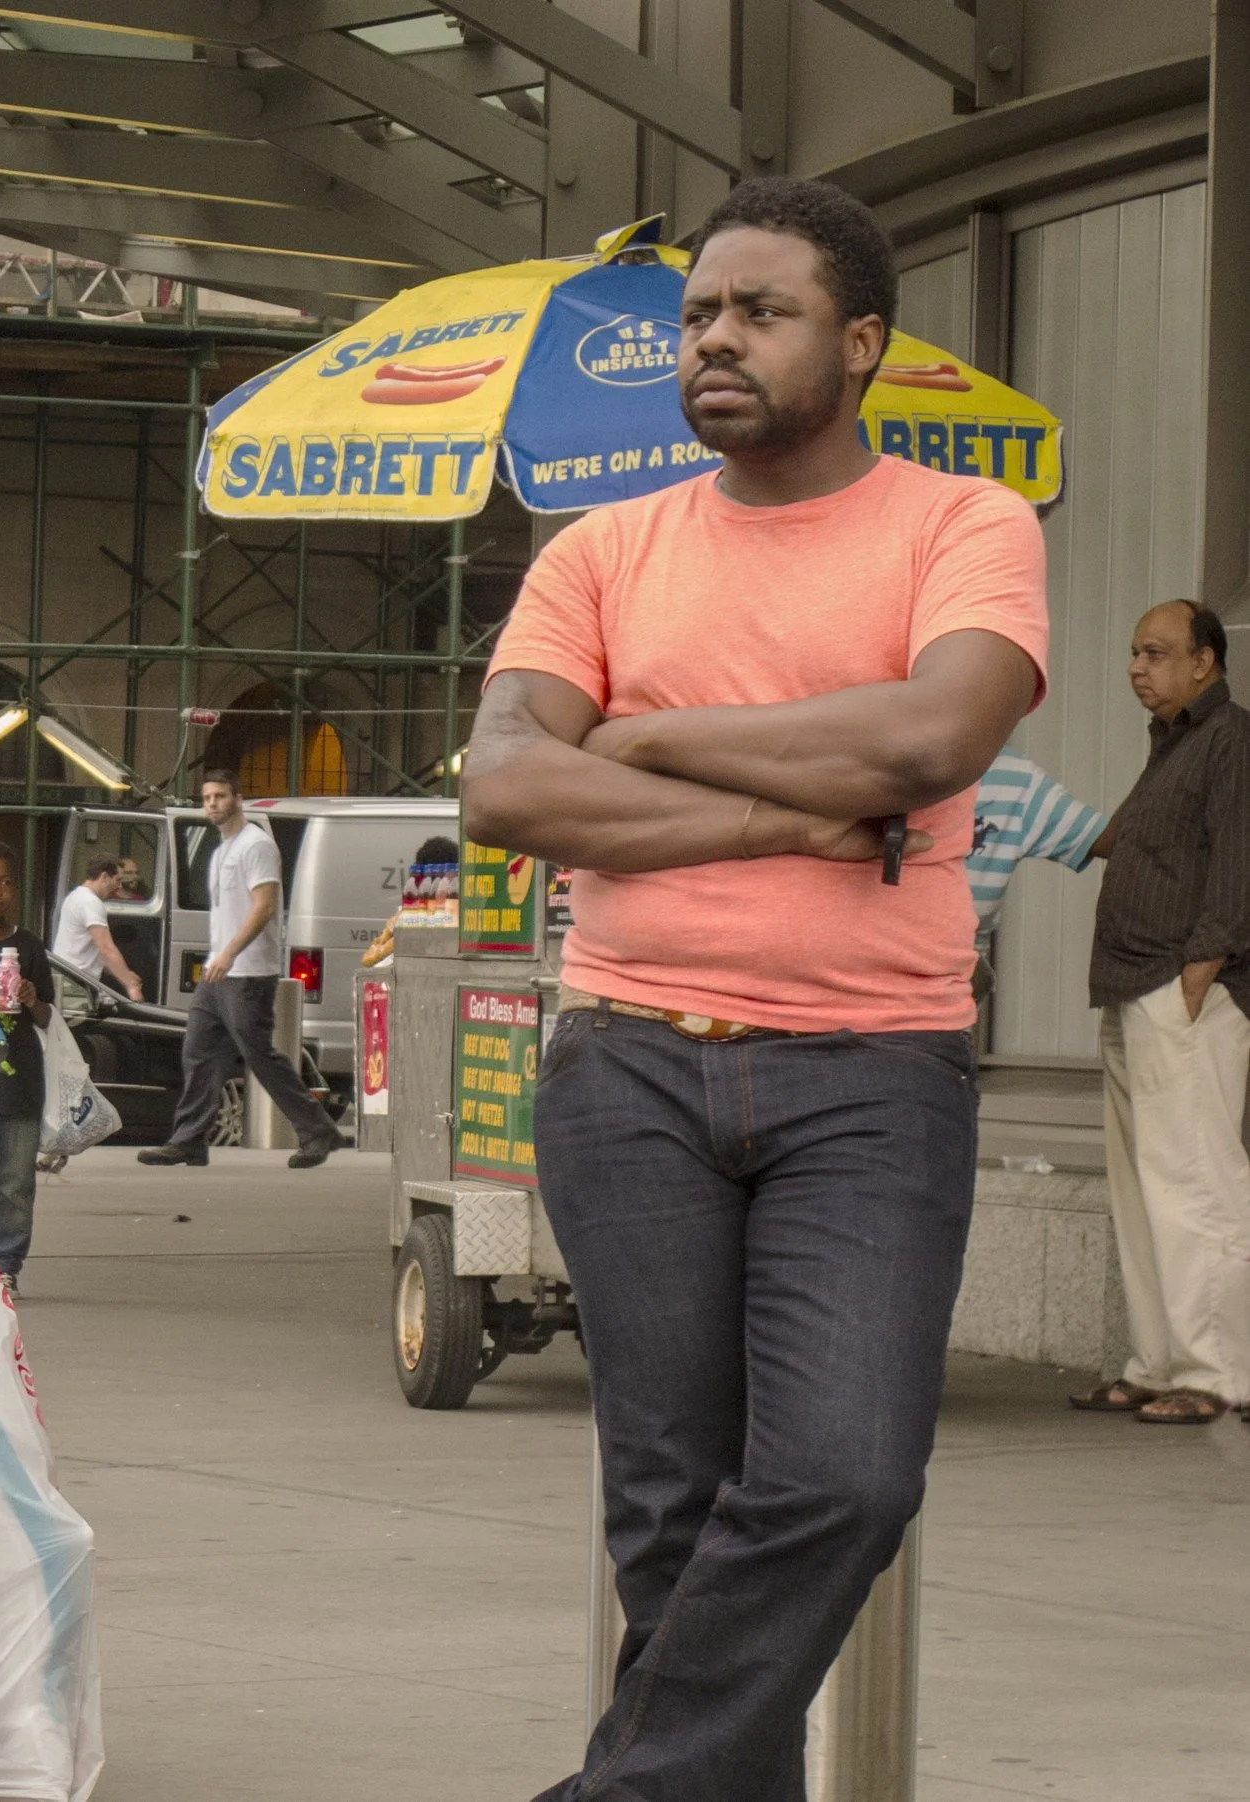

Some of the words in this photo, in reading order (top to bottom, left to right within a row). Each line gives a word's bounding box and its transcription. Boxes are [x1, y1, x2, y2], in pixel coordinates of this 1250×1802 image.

[318, 308, 527, 378] SABRETT
[617, 320, 657, 340] U.S.
[608, 339, 670, 358] GOV'T
[590, 353, 677, 373] INSPECTE
[858, 411, 1046, 480] BRETT
[221, 433, 486, 499] SABRETT
[532, 455, 603, 485] WE'RE
[610, 448, 642, 474] ON
[648, 446, 664, 468] A
[381, 859, 406, 890] zi
[470, 994, 488, 1020] God
[489, 996, 514, 1022] Bless
[479, 1035, 494, 1059] HOT
[494, 1037, 510, 1061] DOG
[478, 1068, 494, 1092] HOT
[462, 1098, 477, 1122] HOT
[512, 1140, 537, 1167] SNAPP
